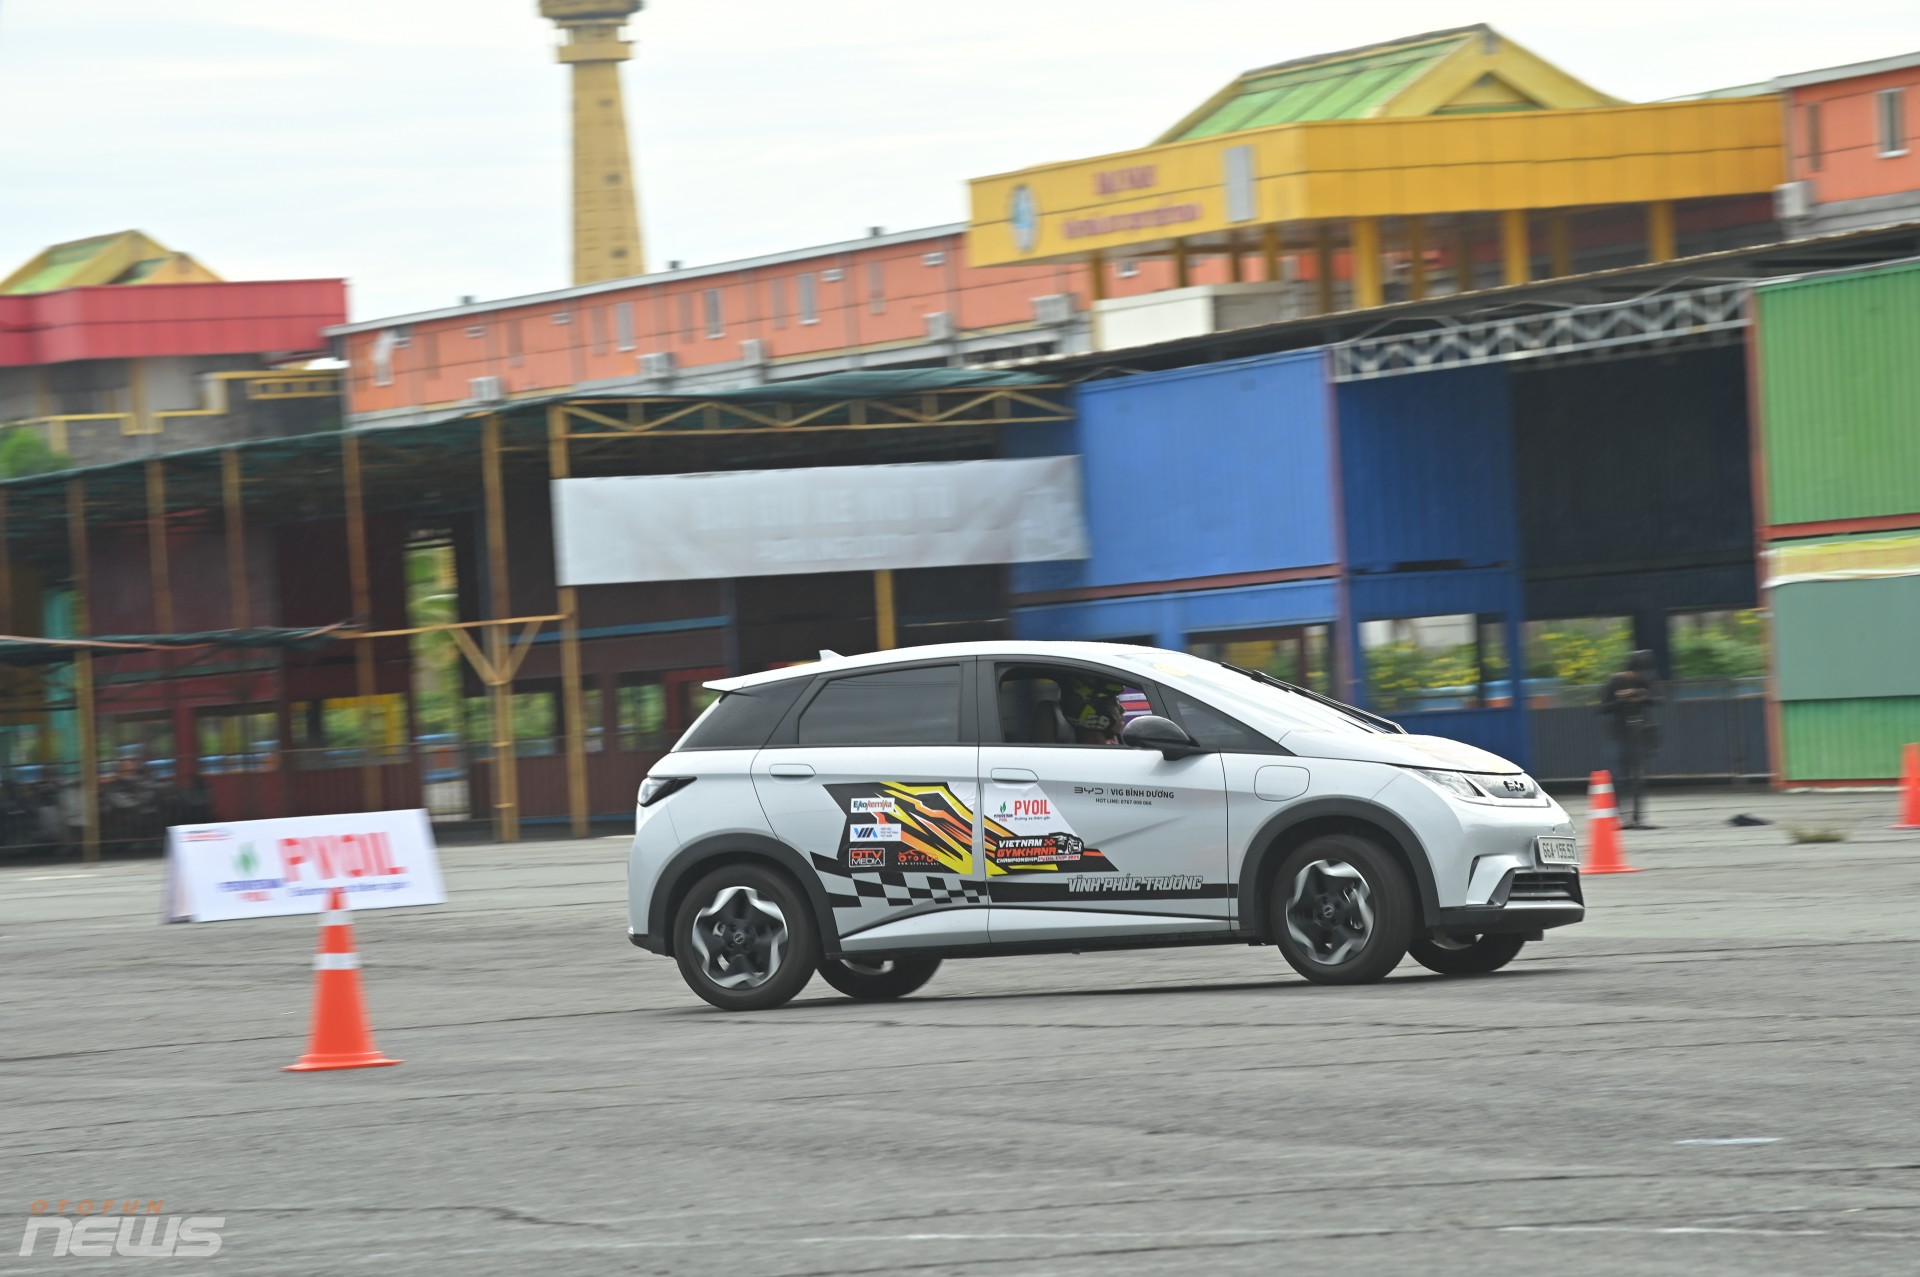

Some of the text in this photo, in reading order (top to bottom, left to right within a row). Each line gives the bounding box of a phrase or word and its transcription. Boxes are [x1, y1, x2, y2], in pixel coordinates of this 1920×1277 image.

[1074, 786, 1175, 799] BYD VIG BÌNH DƯƠNG
[1014, 799, 1051, 815] PVOIL
[998, 838, 1043, 848] VIETNAM
[996, 847, 1057, 858] GYMKHANA
[851, 858, 884, 867] MEDIA
[996, 856, 1038, 864] CHAMPIONSHIP
[1067, 875, 1101, 893] VĨNH
[1100, 873, 1142, 892] PHÚC
